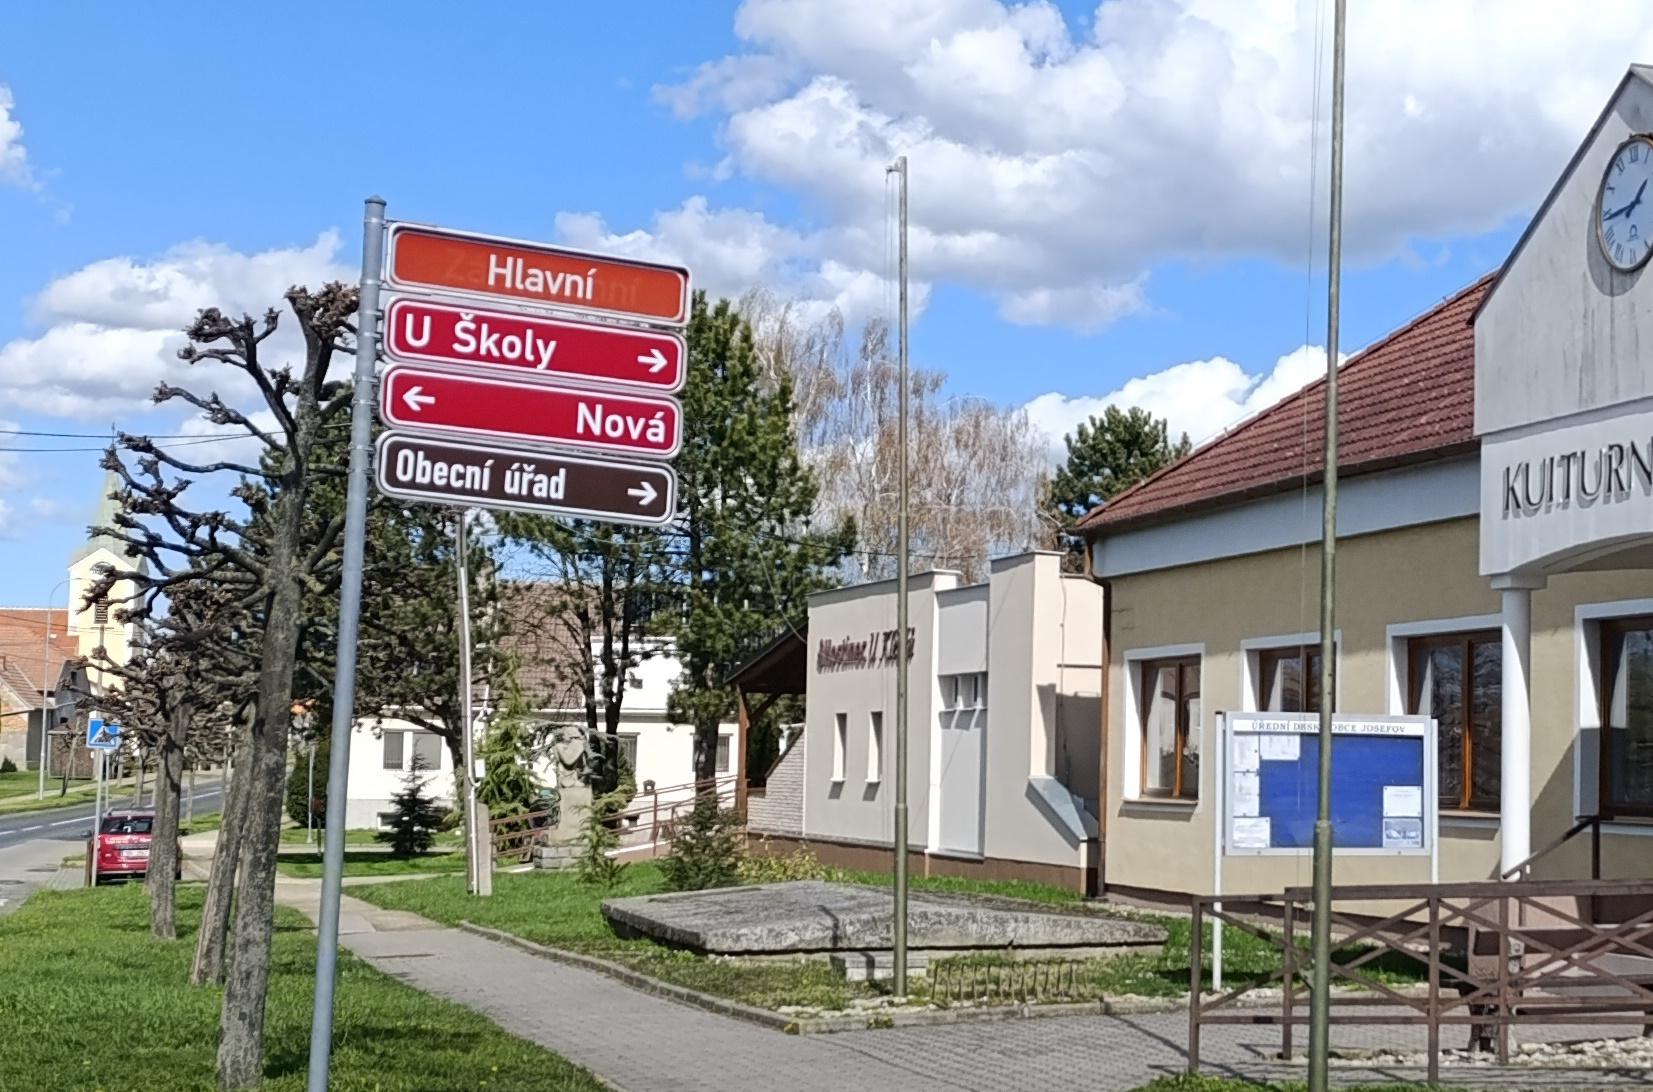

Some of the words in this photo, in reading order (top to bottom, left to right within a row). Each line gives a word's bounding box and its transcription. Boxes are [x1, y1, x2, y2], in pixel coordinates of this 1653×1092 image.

[487, 253, 598, 300] Hlavní
[404, 313, 431, 348] U
[452, 312, 557, 371] Školy
[575, 401, 666, 444] Nová
[395, 449, 495, 491] Obecní
[503, 463, 567, 500] úřad
[1293, 722, 1321, 733] DESK
